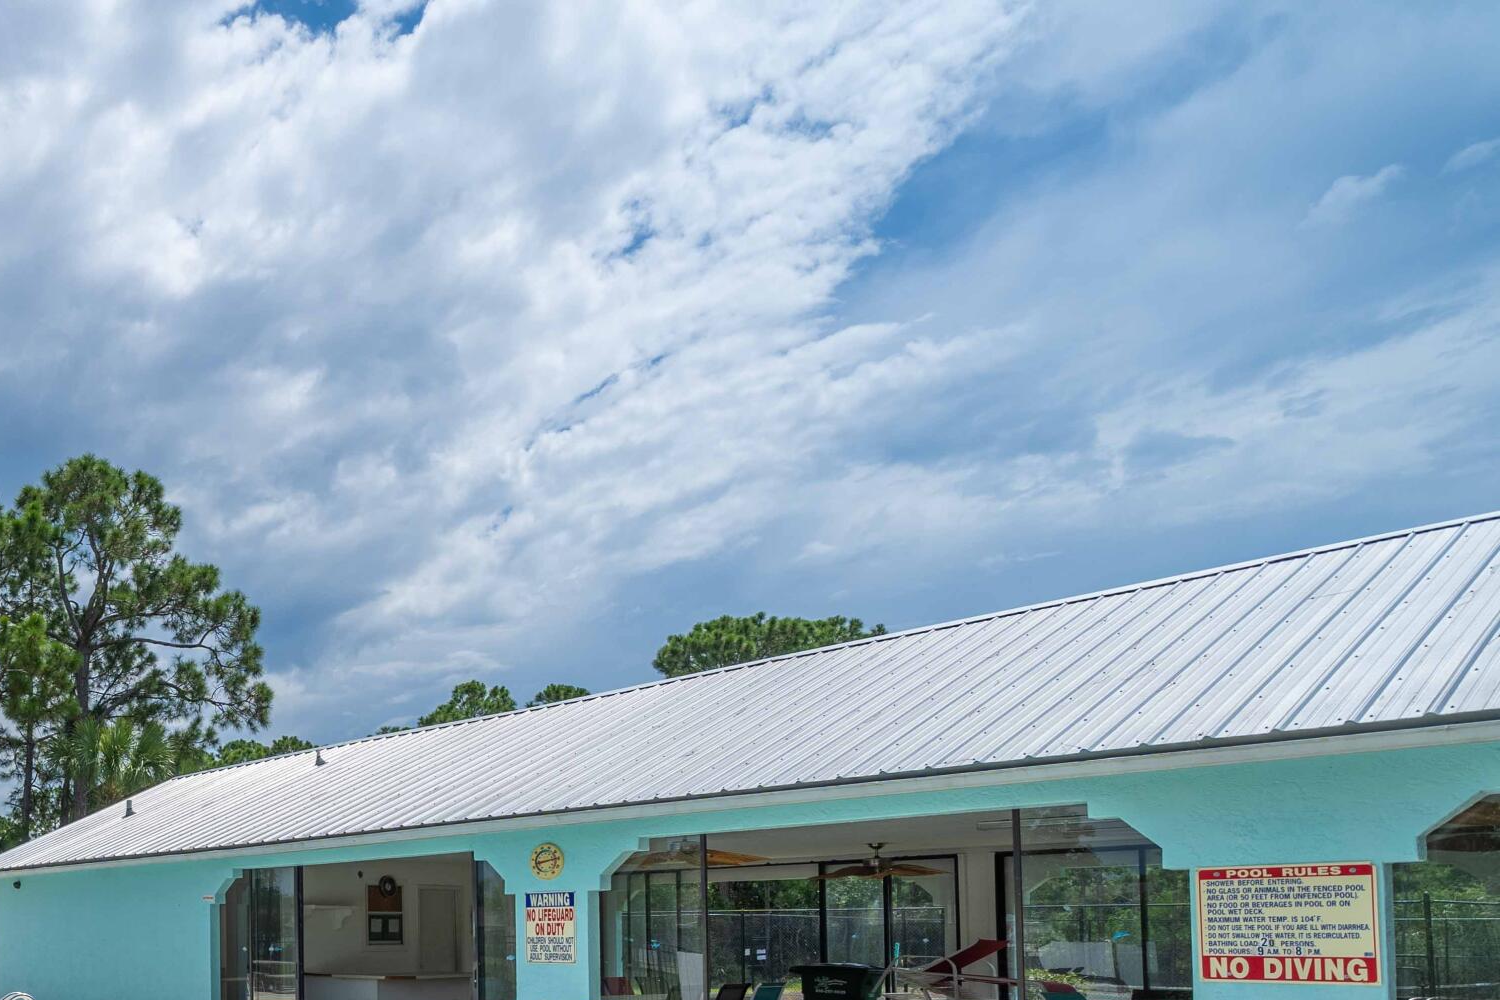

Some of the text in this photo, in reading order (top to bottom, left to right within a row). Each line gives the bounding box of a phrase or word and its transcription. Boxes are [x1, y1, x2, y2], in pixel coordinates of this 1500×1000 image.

[1226, 866, 1341, 878] POOL RULES
[531, 893, 570, 906] WARNING
[527, 909, 573, 921] NO LIFEGUARD
[535, 923, 565, 935] ON DUTY
[1261, 938, 1274, 946] 20
[1258, 947, 1264, 955] 9
[1296, 947, 1302, 955] 8
[1210, 957, 1368, 981] NO DIVING
